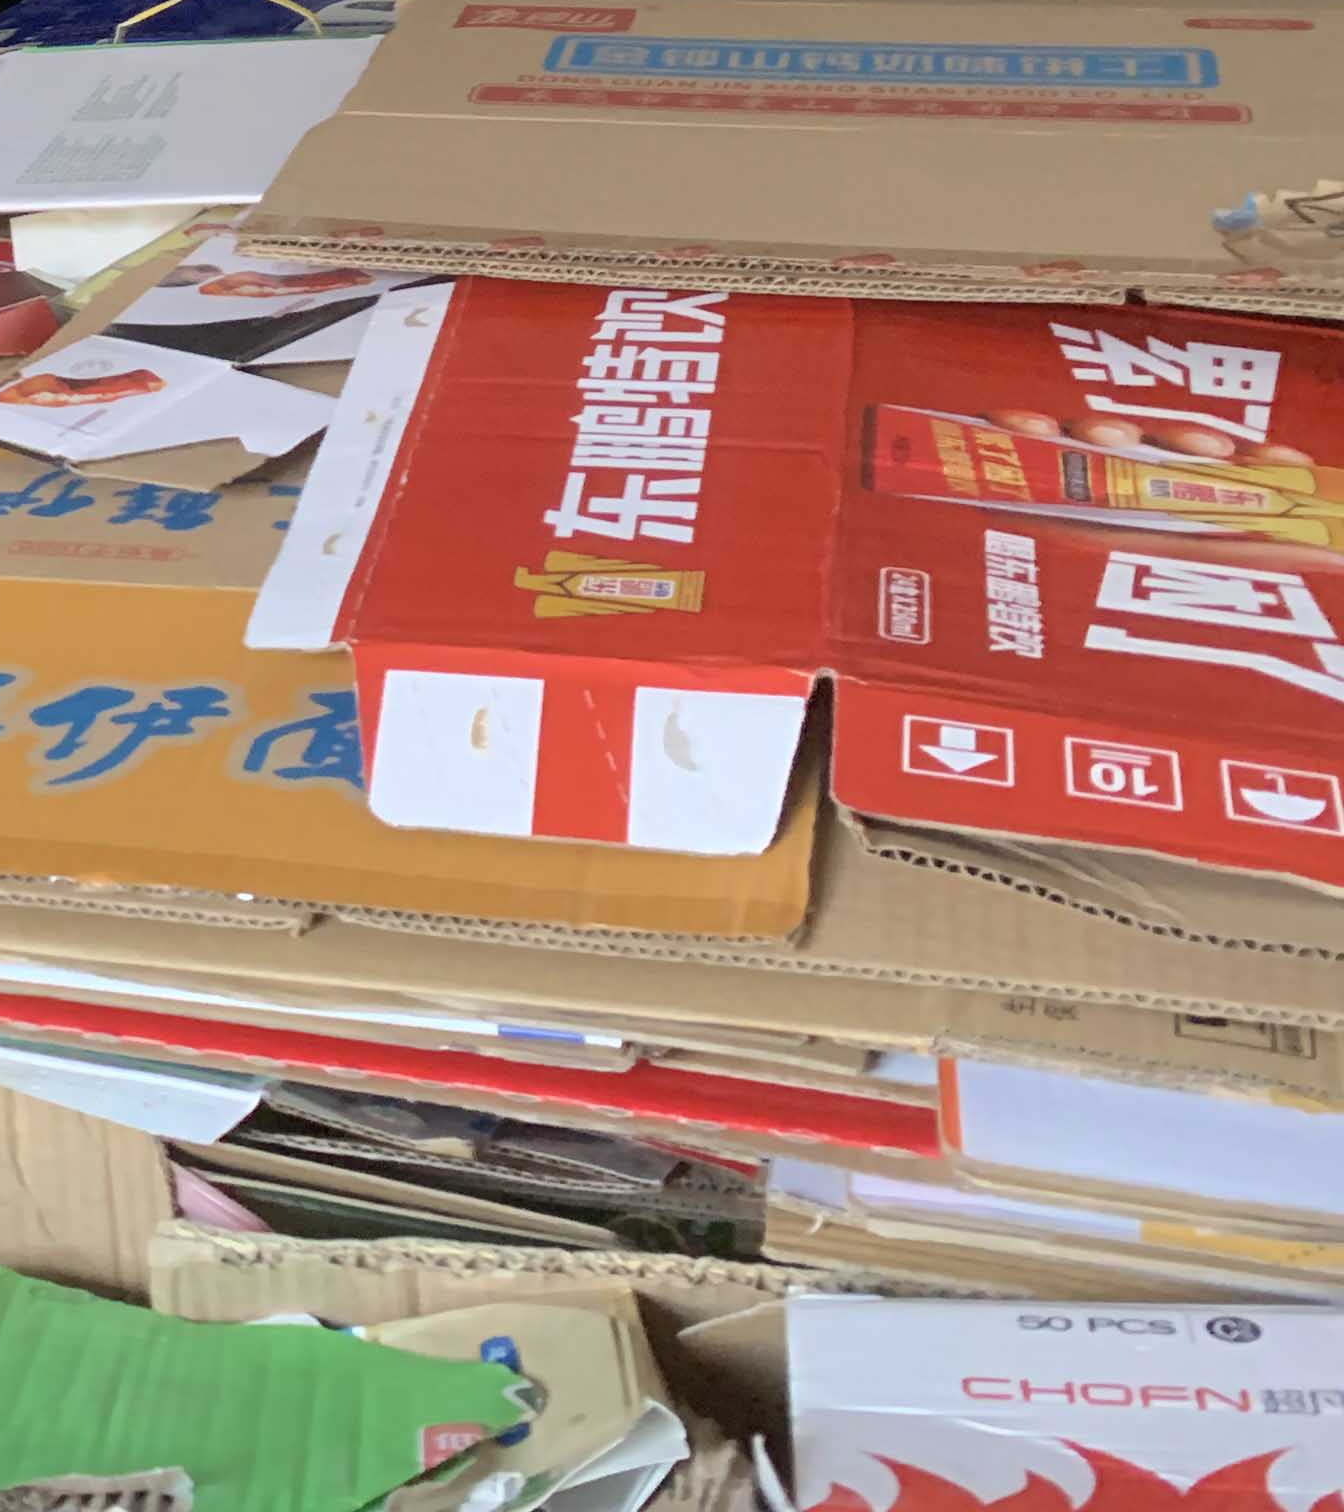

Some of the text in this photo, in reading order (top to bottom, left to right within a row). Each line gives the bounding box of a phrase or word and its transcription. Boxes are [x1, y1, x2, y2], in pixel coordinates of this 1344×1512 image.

[542, 289, 730, 544] 东鹏特饮
[1089, 764, 1159, 799] 10
[1017, 1314, 1177, 1336] 50 PCS
[961, 1375, 1251, 1414] CHOFN
